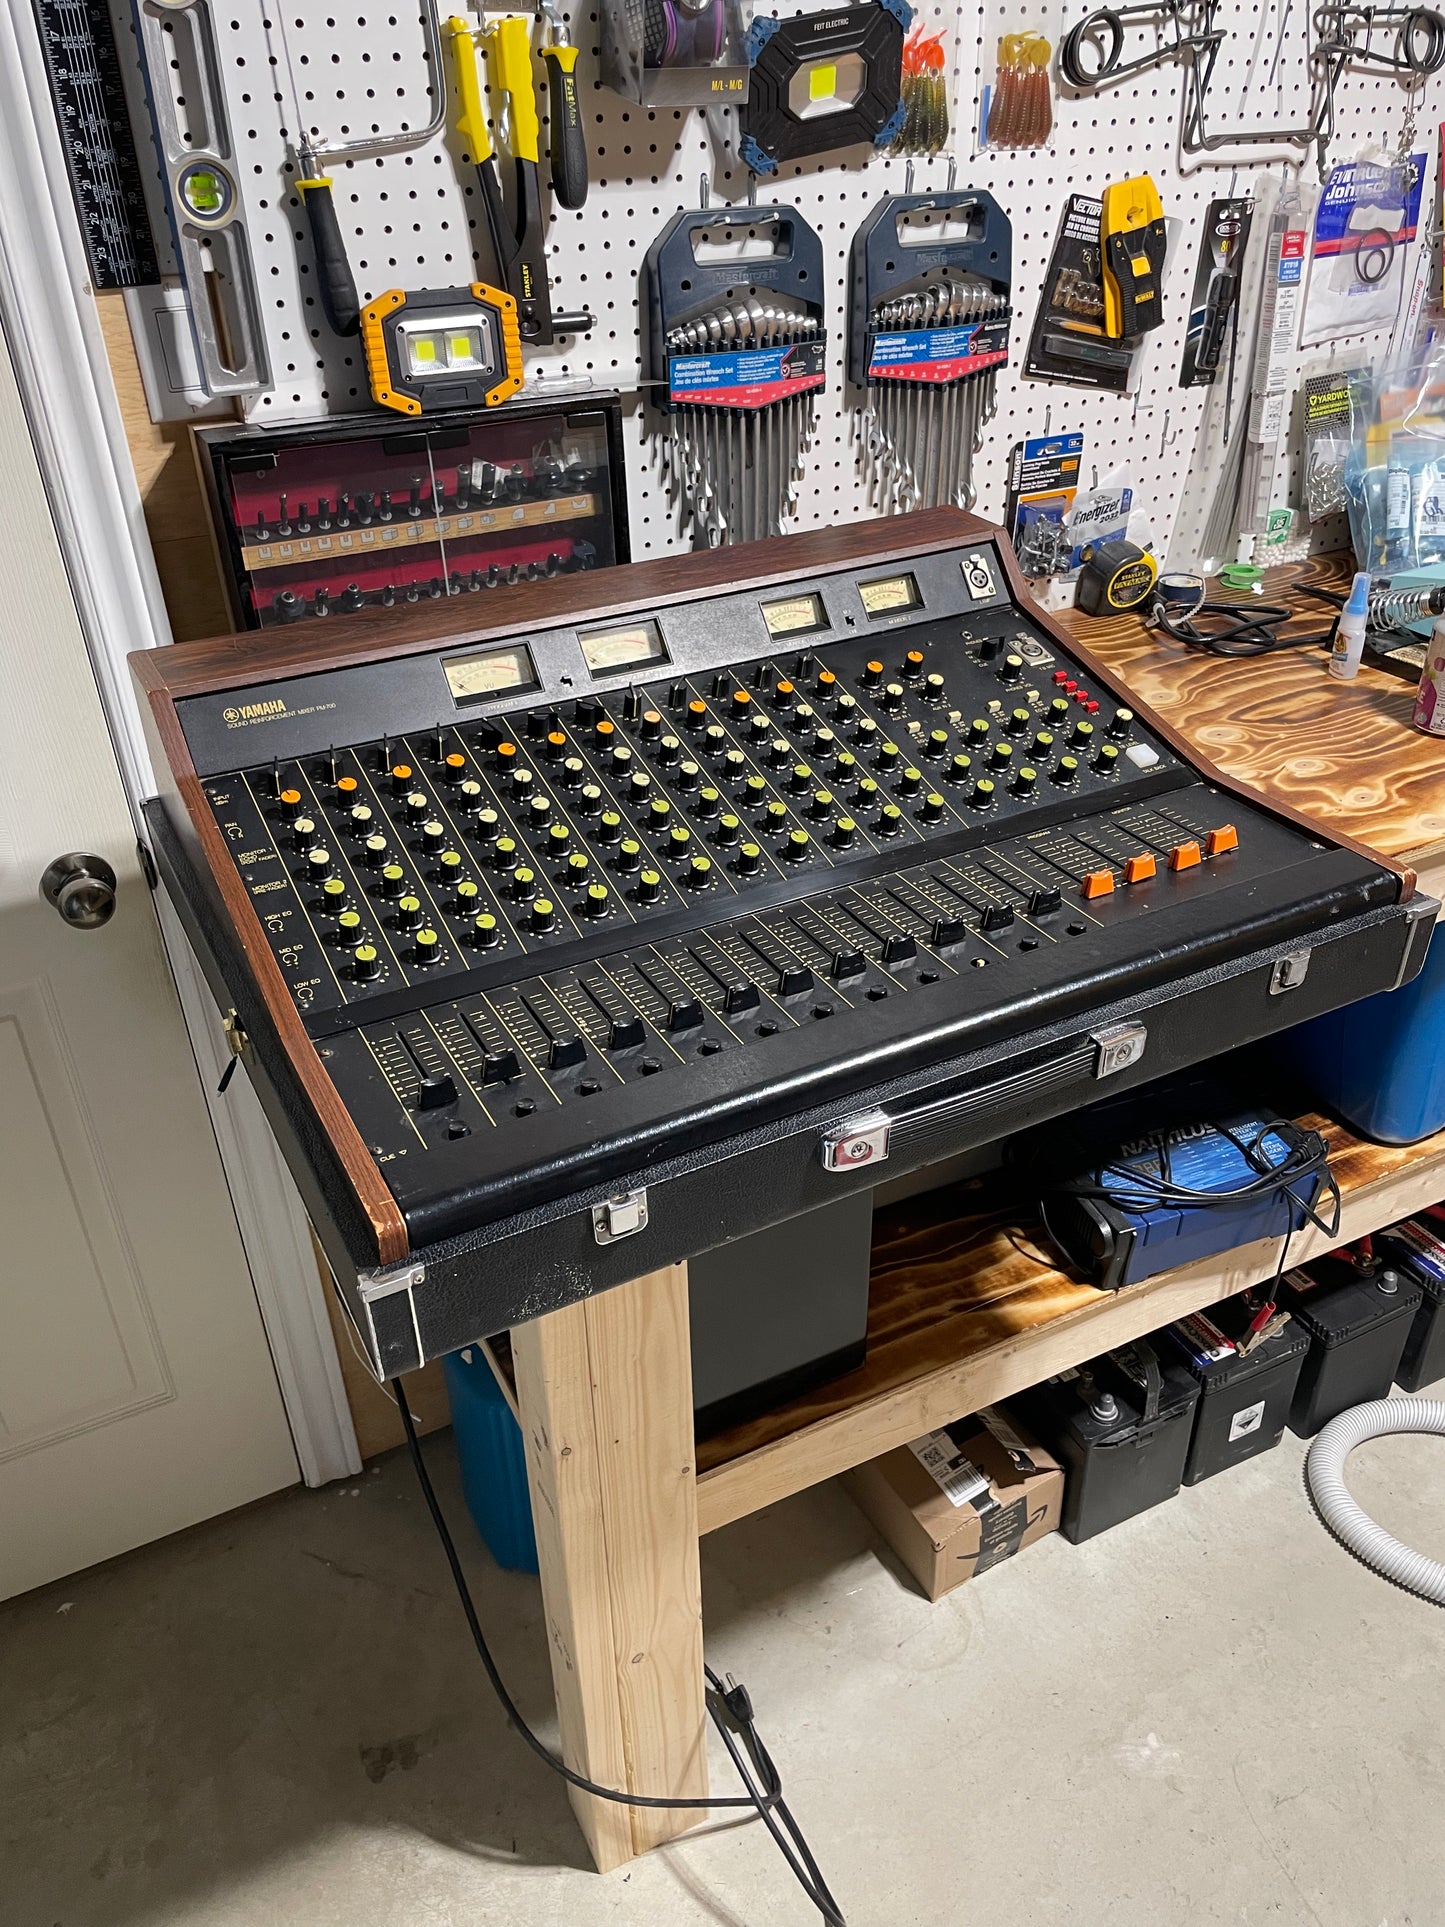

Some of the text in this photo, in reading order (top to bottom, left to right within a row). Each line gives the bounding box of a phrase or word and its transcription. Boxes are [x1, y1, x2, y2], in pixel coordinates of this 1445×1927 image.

[813, 17, 849, 31] FEIT ELECTRIC
[50, 30, 60, 42] 17
[58, 68, 68, 79] 18
[711, 80, 724, 91] M/L
[729, 79, 742, 91] M/G
[66, 105, 76, 116] 19
[73, 140, 84, 155] 20
[82, 180, 92, 190] 21
[89, 212, 99, 225] 22
[1073, 223, 1080, 231] DE
[97, 247, 107, 259] 23
[522, 264, 531, 298] STANLEY
[674, 368, 705, 378] Combination
[706, 368, 724, 377] Wrench
[675, 378, 684, 386] Jeu
[692, 376, 701, 384] clés
[703, 376, 719, 384] mixtes
[1073, 498, 1120, 526] Energizer
[1100, 511, 1119, 523] 2032
[1121, 571, 1146, 581] STANLEY
[239, 699, 287, 719] YAMAHA
[227, 721, 249, 730] SOUND
[249, 710, 297, 725] REINFORCEMENT
[297, 706, 316, 715] MIXER
[264, 913, 280, 921] HIGH
[294, 981, 309, 989] LOW
[379, 1153, 397, 1163] CUE
